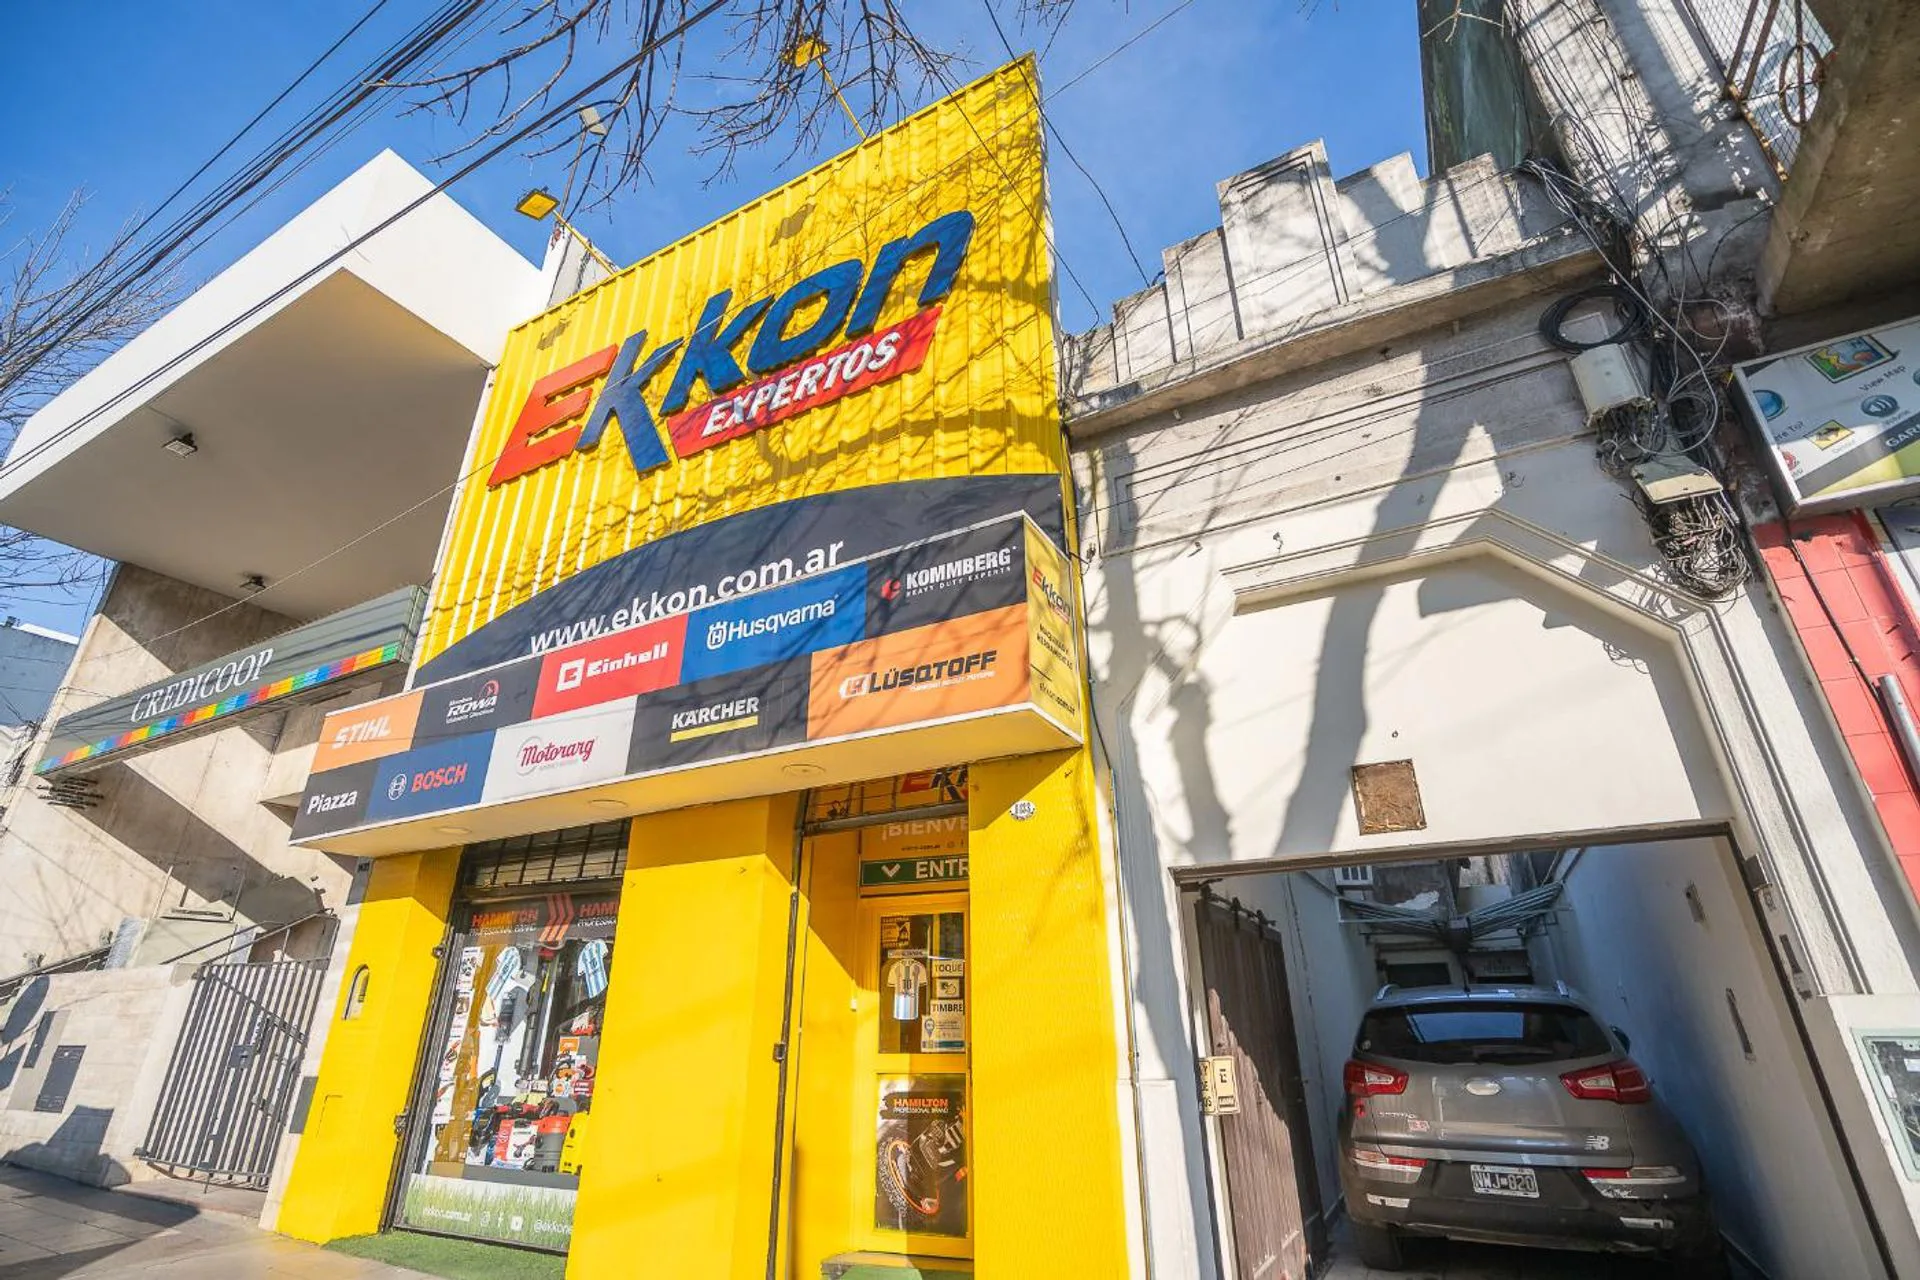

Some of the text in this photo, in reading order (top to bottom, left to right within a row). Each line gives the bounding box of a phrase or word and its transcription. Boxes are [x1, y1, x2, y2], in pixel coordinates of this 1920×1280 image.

[701, 332, 902, 437] EXPERTOS
[906, 547, 1012, 590] KOMMBERG
[906, 566, 1011, 597] HEAVY DUTY EXPERTS
[530, 538, 845, 655] www.ekkon.com.ar
[728, 598, 836, 642] Husqvarna
[586, 641, 669, 678] Einhell
[869, 650, 997, 694] LÜSQTOFF
[130, 648, 274, 723] CREDICOOP
[447, 695, 498, 717] ROWA
[671, 697, 759, 729] KÄRCHER
[332, 715, 392, 750] STIHL
[521, 737, 595, 767] Motorarg
[411, 763, 468, 793] BOSCH
[306, 790, 358, 815] Piazza
[934, 964, 963, 973] TOQUE
[932, 1003, 963, 1013] TIMBRE
[894, 1098, 949, 1108] HAMILTON
[1507, 1175, 1536, 1192] 820
